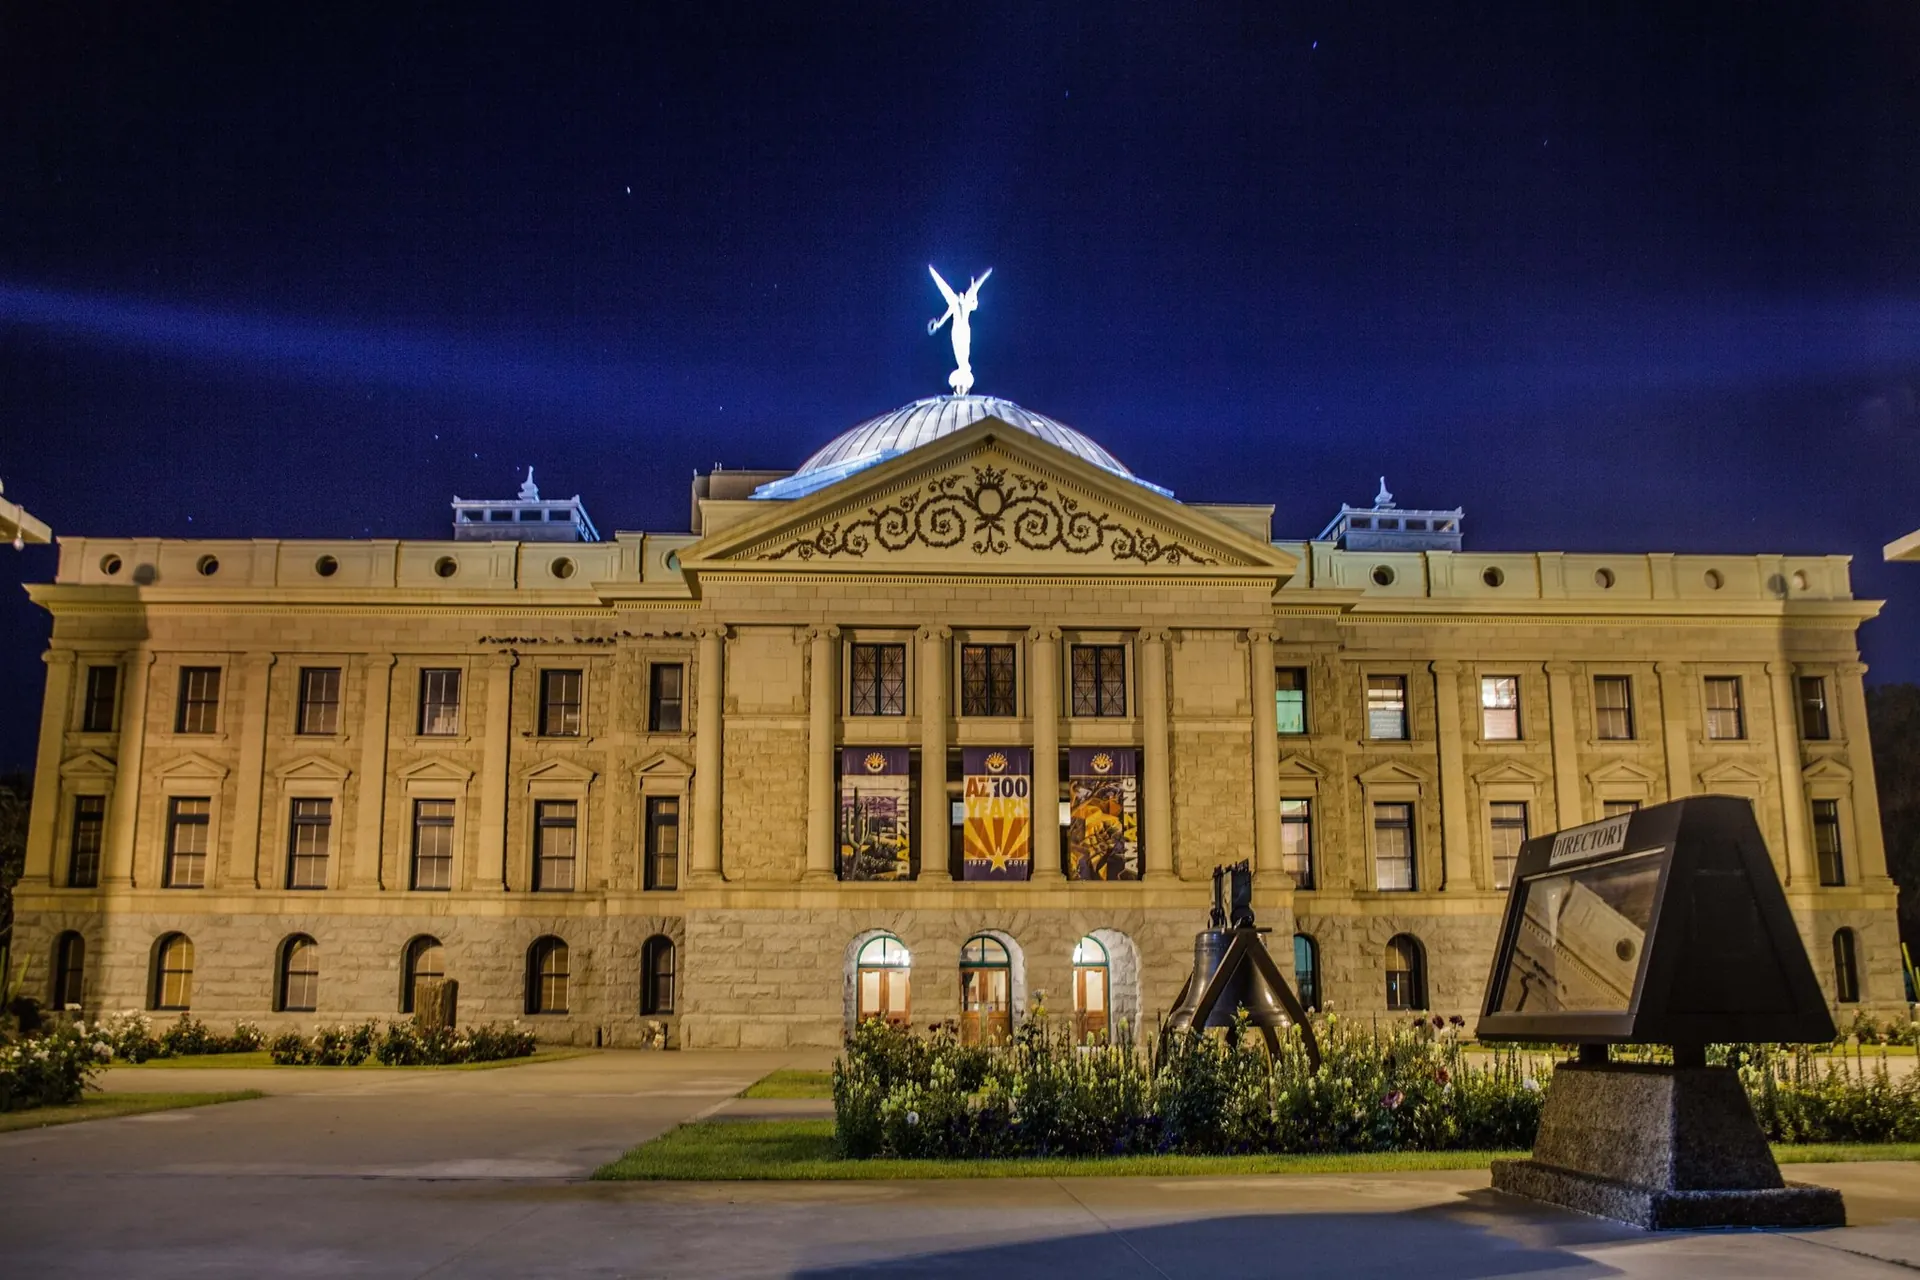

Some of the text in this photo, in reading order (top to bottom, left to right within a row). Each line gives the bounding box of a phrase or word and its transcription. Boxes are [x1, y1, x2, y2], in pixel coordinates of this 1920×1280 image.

[965, 798, 1029, 818] YEARS
[1123, 777, 1139, 875] AMAZING
[1552, 823, 1627, 858] DIRECTORY
